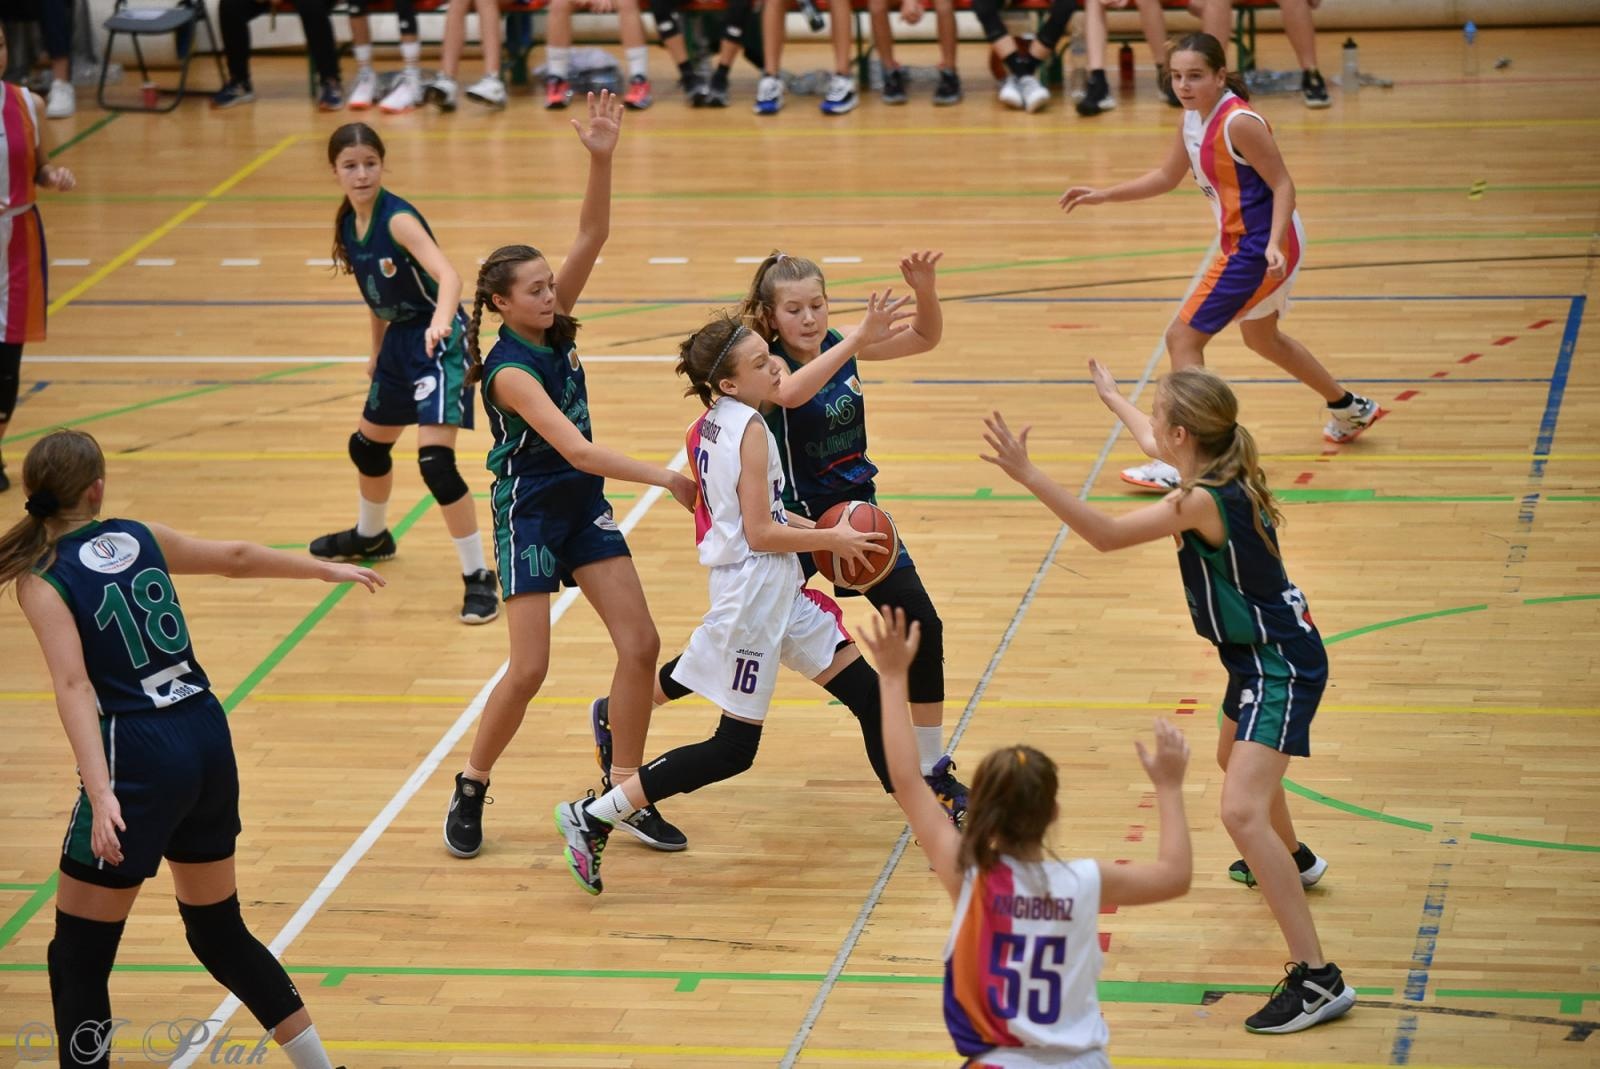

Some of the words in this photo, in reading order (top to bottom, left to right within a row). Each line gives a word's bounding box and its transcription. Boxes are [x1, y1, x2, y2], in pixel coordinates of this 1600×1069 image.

[825, 394, 856, 430] 16
[694, 446, 713, 516] 6
[520, 544, 557, 578] 10
[94, 567, 189, 669] 18
[731, 657, 760, 694] 16
[988, 932, 1066, 1025] 55
